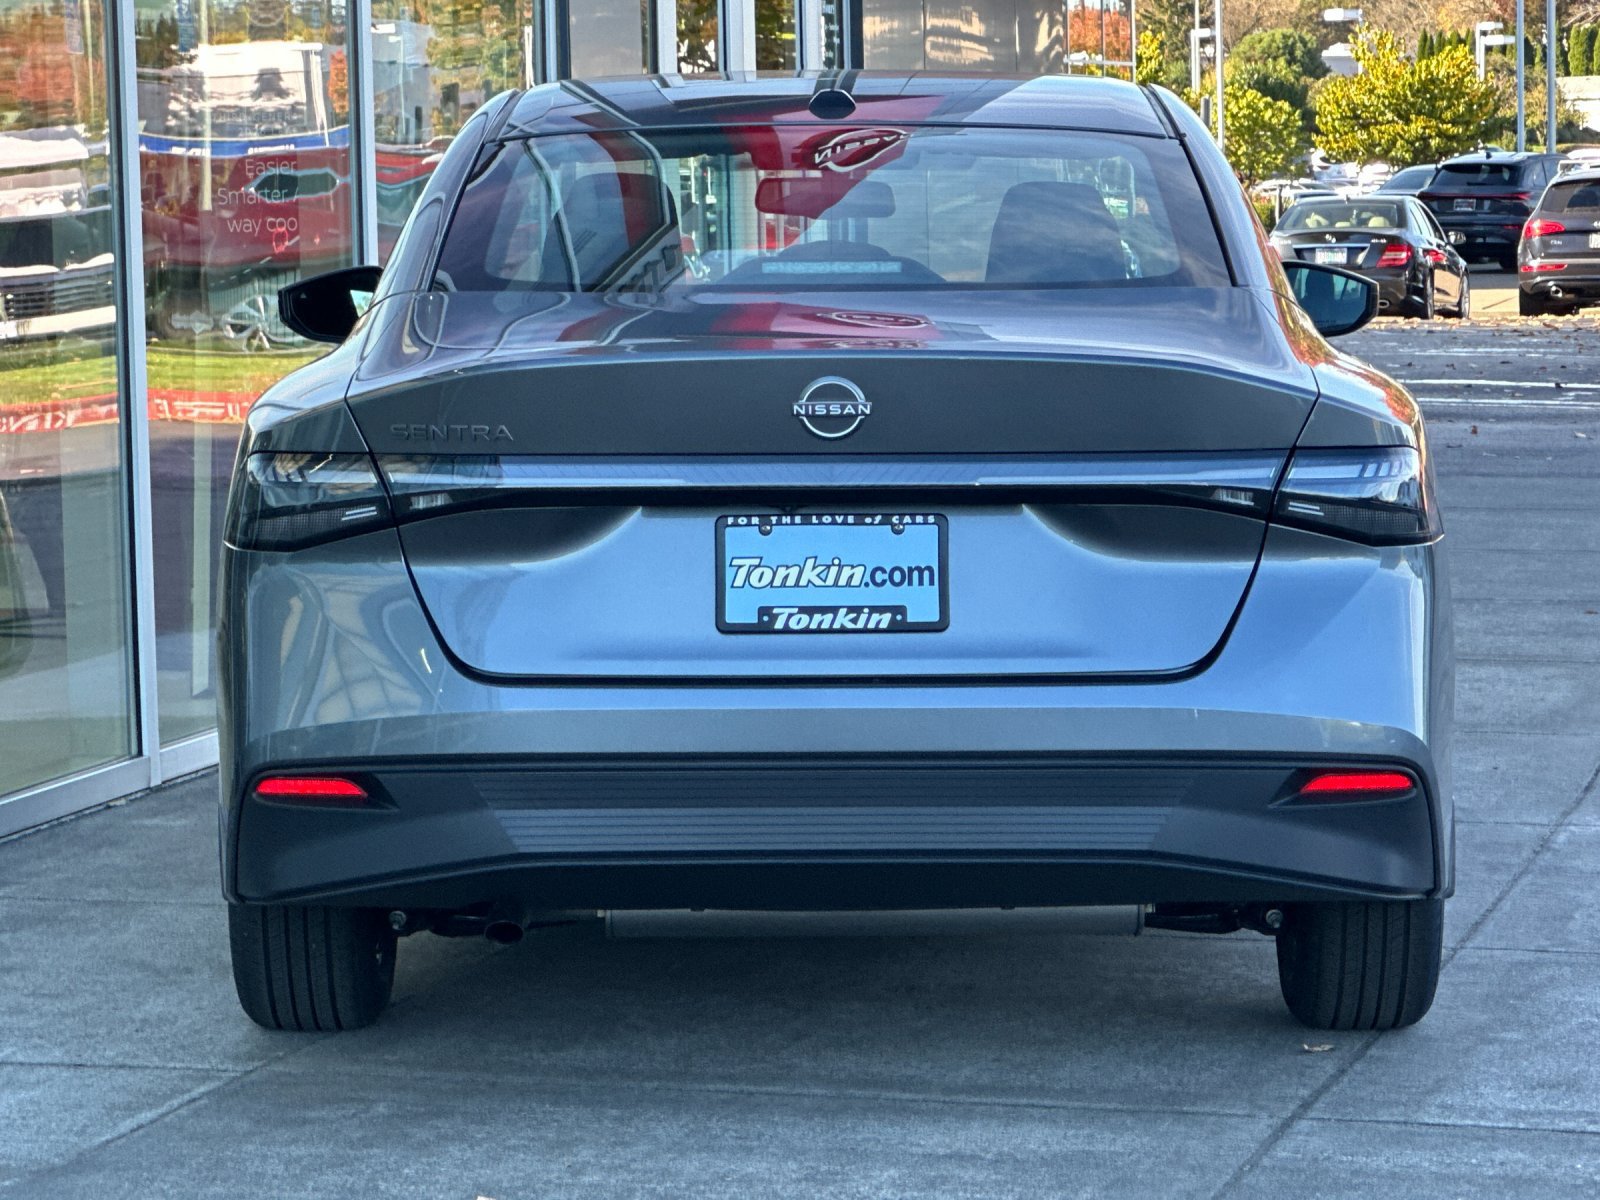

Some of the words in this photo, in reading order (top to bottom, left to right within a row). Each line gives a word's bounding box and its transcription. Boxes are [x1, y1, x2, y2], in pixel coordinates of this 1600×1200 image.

[244, 159, 298, 177] Easier
[226, 219, 263, 237] way
[793, 403, 871, 416] NISSAN
[389, 423, 514, 441] SENTRA
[727, 516, 760, 525] FOR
[770, 515, 802, 524] THE
[811, 515, 855, 524] LOVE
[891, 515, 935, 524] CARS
[729, 555, 936, 589] Tonkin.com
[772, 607, 892, 630] Tonkin
